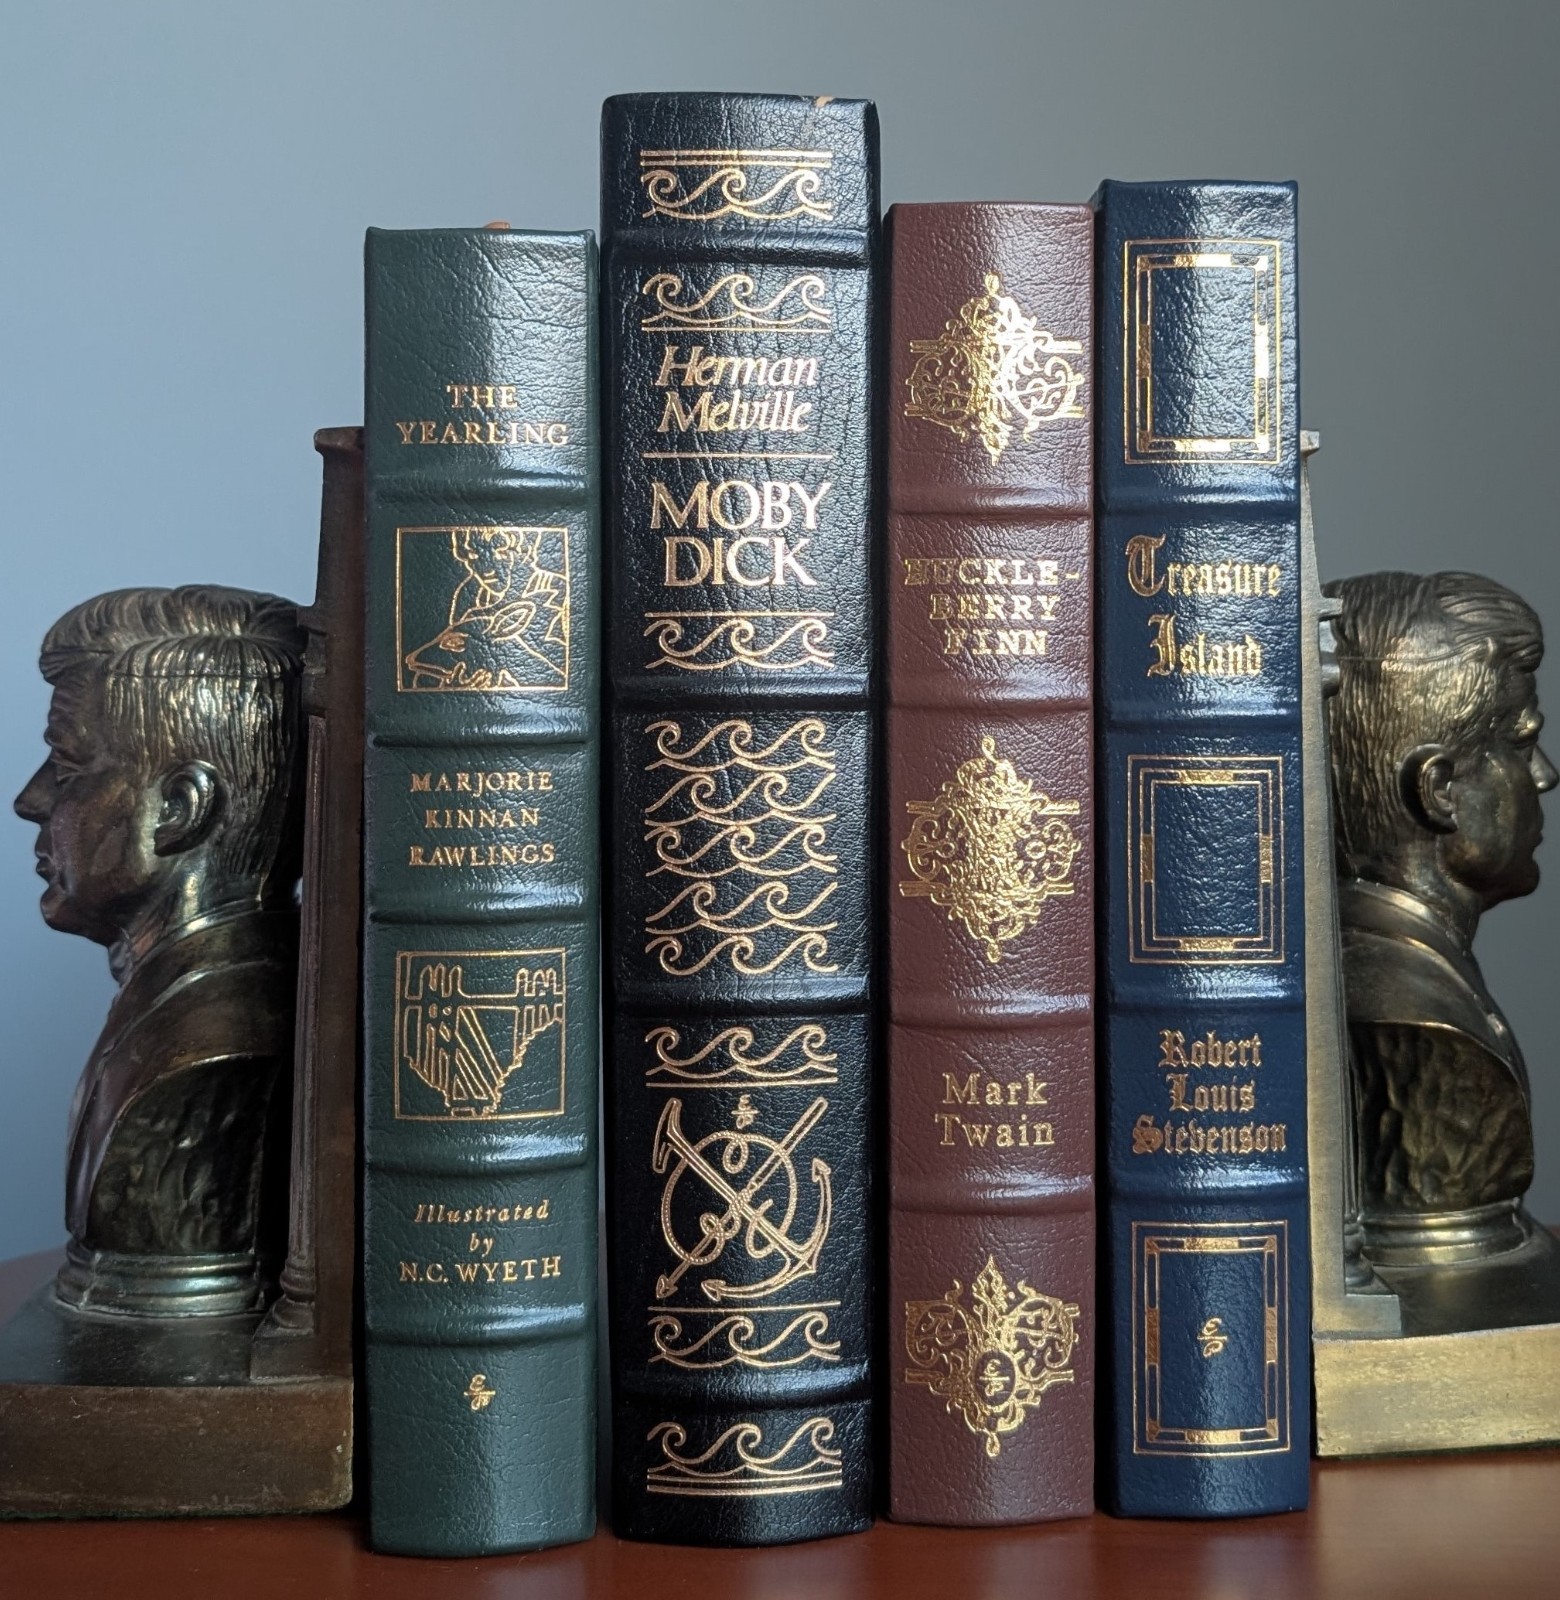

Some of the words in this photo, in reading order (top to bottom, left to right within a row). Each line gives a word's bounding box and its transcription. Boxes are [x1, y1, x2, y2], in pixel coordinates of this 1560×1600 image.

[655, 345, 818, 387] Herman
[446, 384, 518, 409] THE
[657, 389, 812, 433] Melville
[396, 420, 569, 446] YEARLING
[650, 480, 832, 530] MOBY
[663, 535, 817, 587] DICK
[904, 557, 1080, 586] HUCKLE-
[1125, 533, 1282, 597] Treasure
[929, 593, 1061, 621] BERRY
[944, 627, 1049, 656] FINN
[1147, 613, 1263, 677] Island
[410, 771, 554, 798] MARJORIE
[424, 808, 540, 829] KINNAN
[409, 842, 556, 867] RAWLINGS
[1158, 1029, 1262, 1068] Robert
[942, 1072, 1048, 1105] Mark
[1166, 1073, 1256, 1113] Louis
[934, 1113, 1055, 1147] Twain
[1132, 1114, 1287, 1154] Stevenson
[414, 1198, 550, 1223] Illustrated
[469, 1232, 494, 1258] by
[399, 1261, 449, 1283] N.C.
[455, 1254, 562, 1283] WYETH
